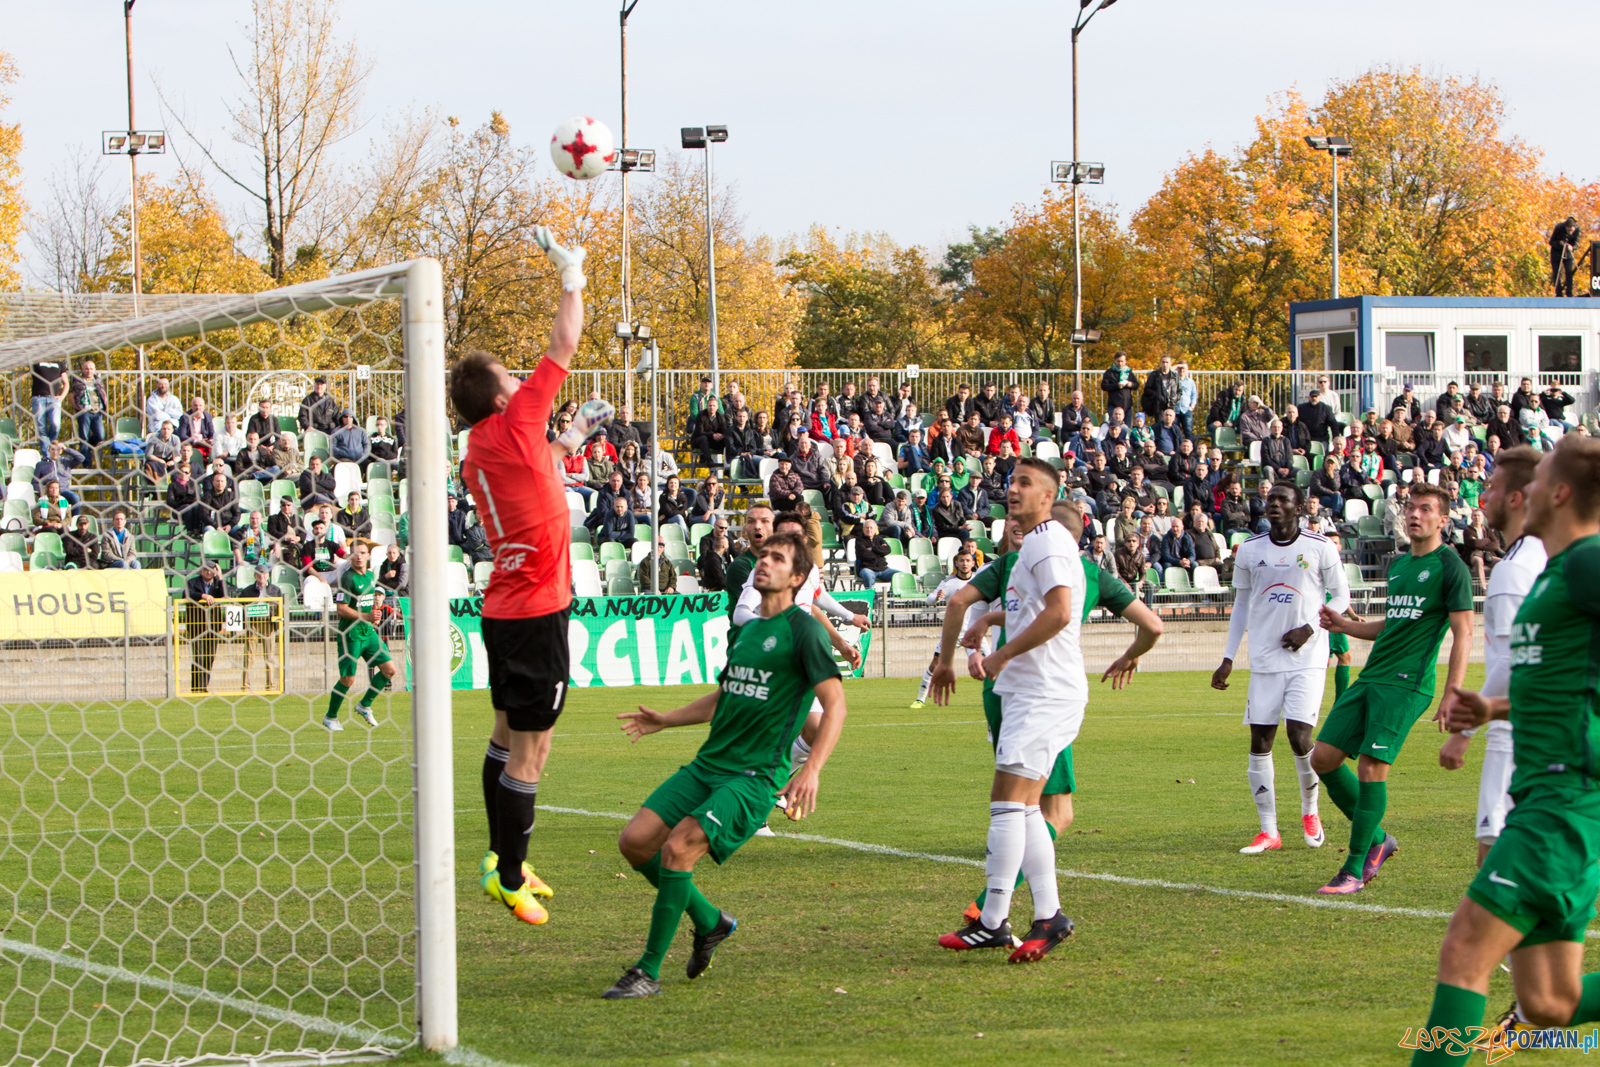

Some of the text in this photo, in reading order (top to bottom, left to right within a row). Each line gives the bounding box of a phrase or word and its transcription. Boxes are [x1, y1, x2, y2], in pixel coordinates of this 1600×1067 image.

[13, 591, 125, 616] HOUSE
[1268, 593, 1294, 603] PGE
[450, 598, 483, 617] NAS
[1387, 608, 1424, 620] OUSE
[227, 610, 241, 626] 34
[552, 680, 564, 710] 1
